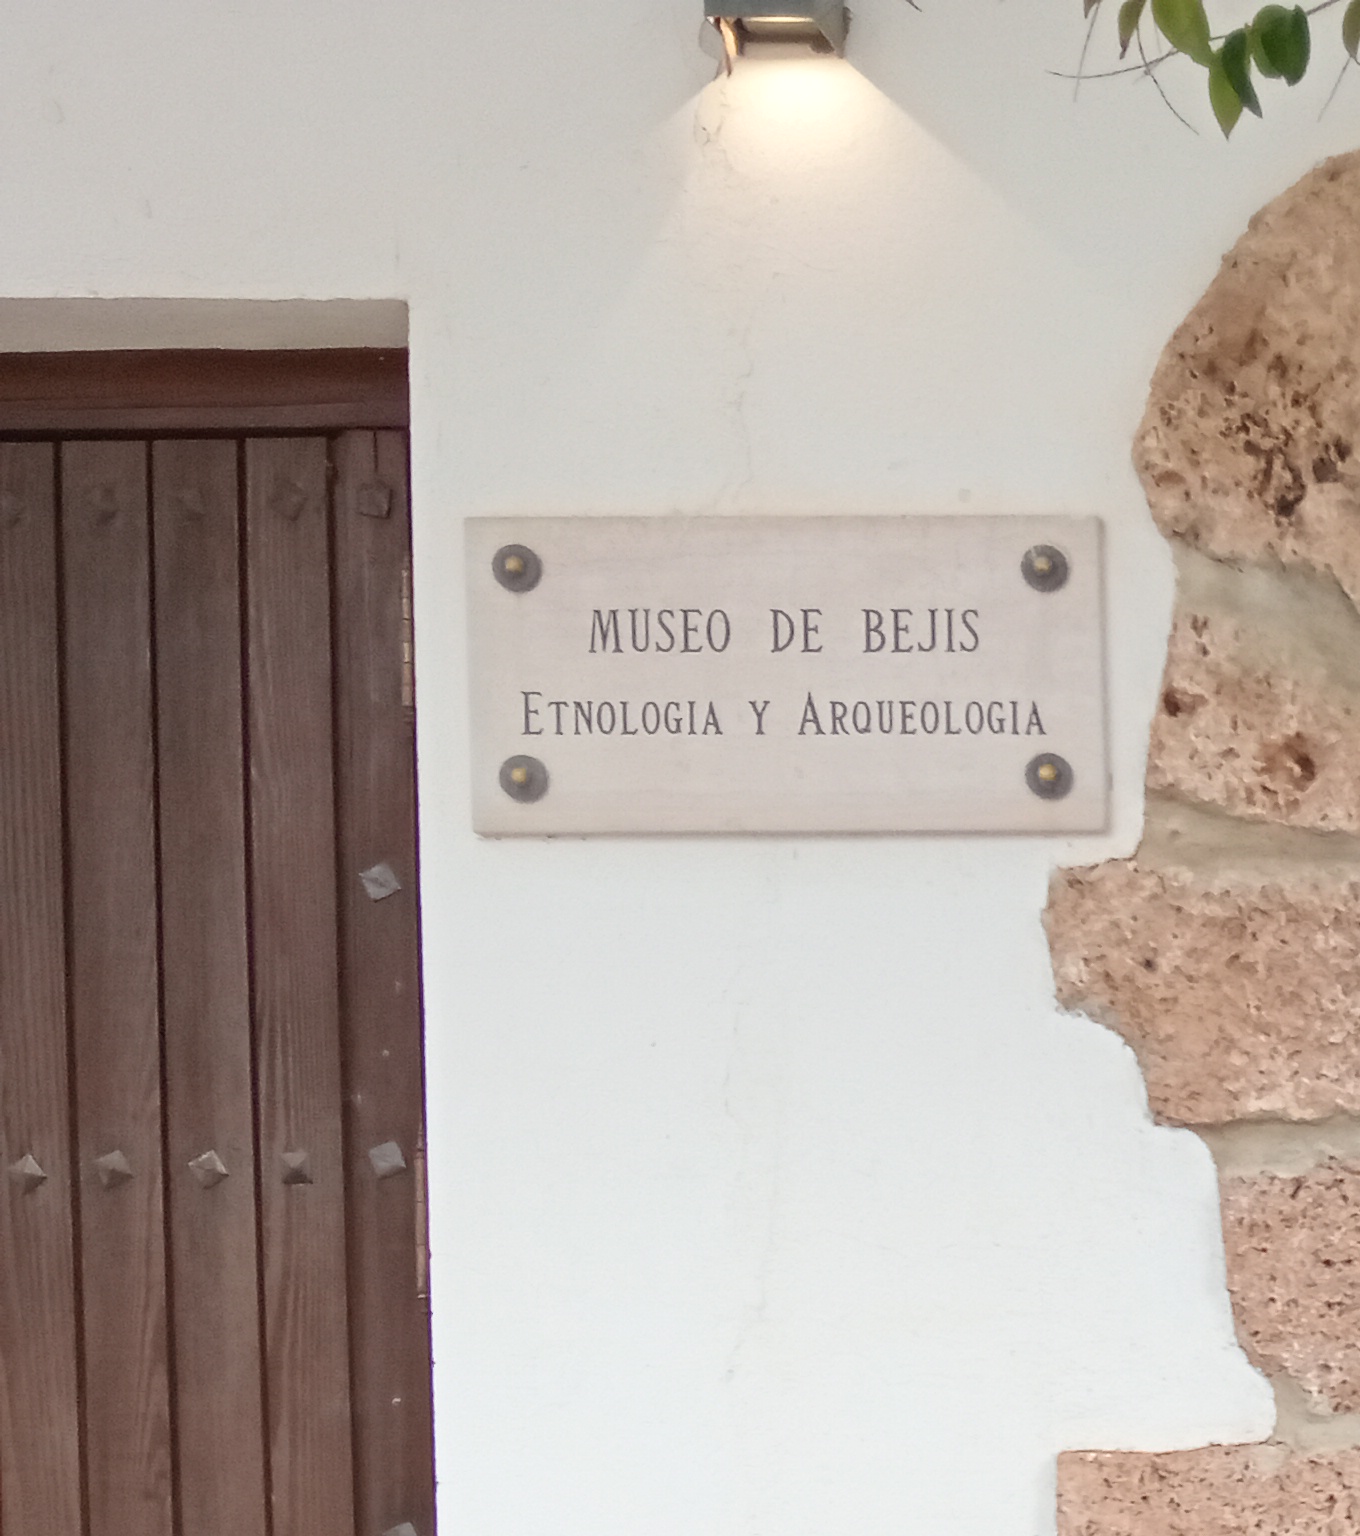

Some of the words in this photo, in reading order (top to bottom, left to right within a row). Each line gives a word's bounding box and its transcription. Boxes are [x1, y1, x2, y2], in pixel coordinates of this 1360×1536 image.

[587, 608, 732, 654] MUSEO
[770, 608, 824, 654] DE
[861, 608, 982, 654] BEJIS
[520, 690, 724, 737] ETNOLOGIA
[748, 700, 771, 737] Y
[797, 691, 1048, 737] ARQUEOLOGIA
